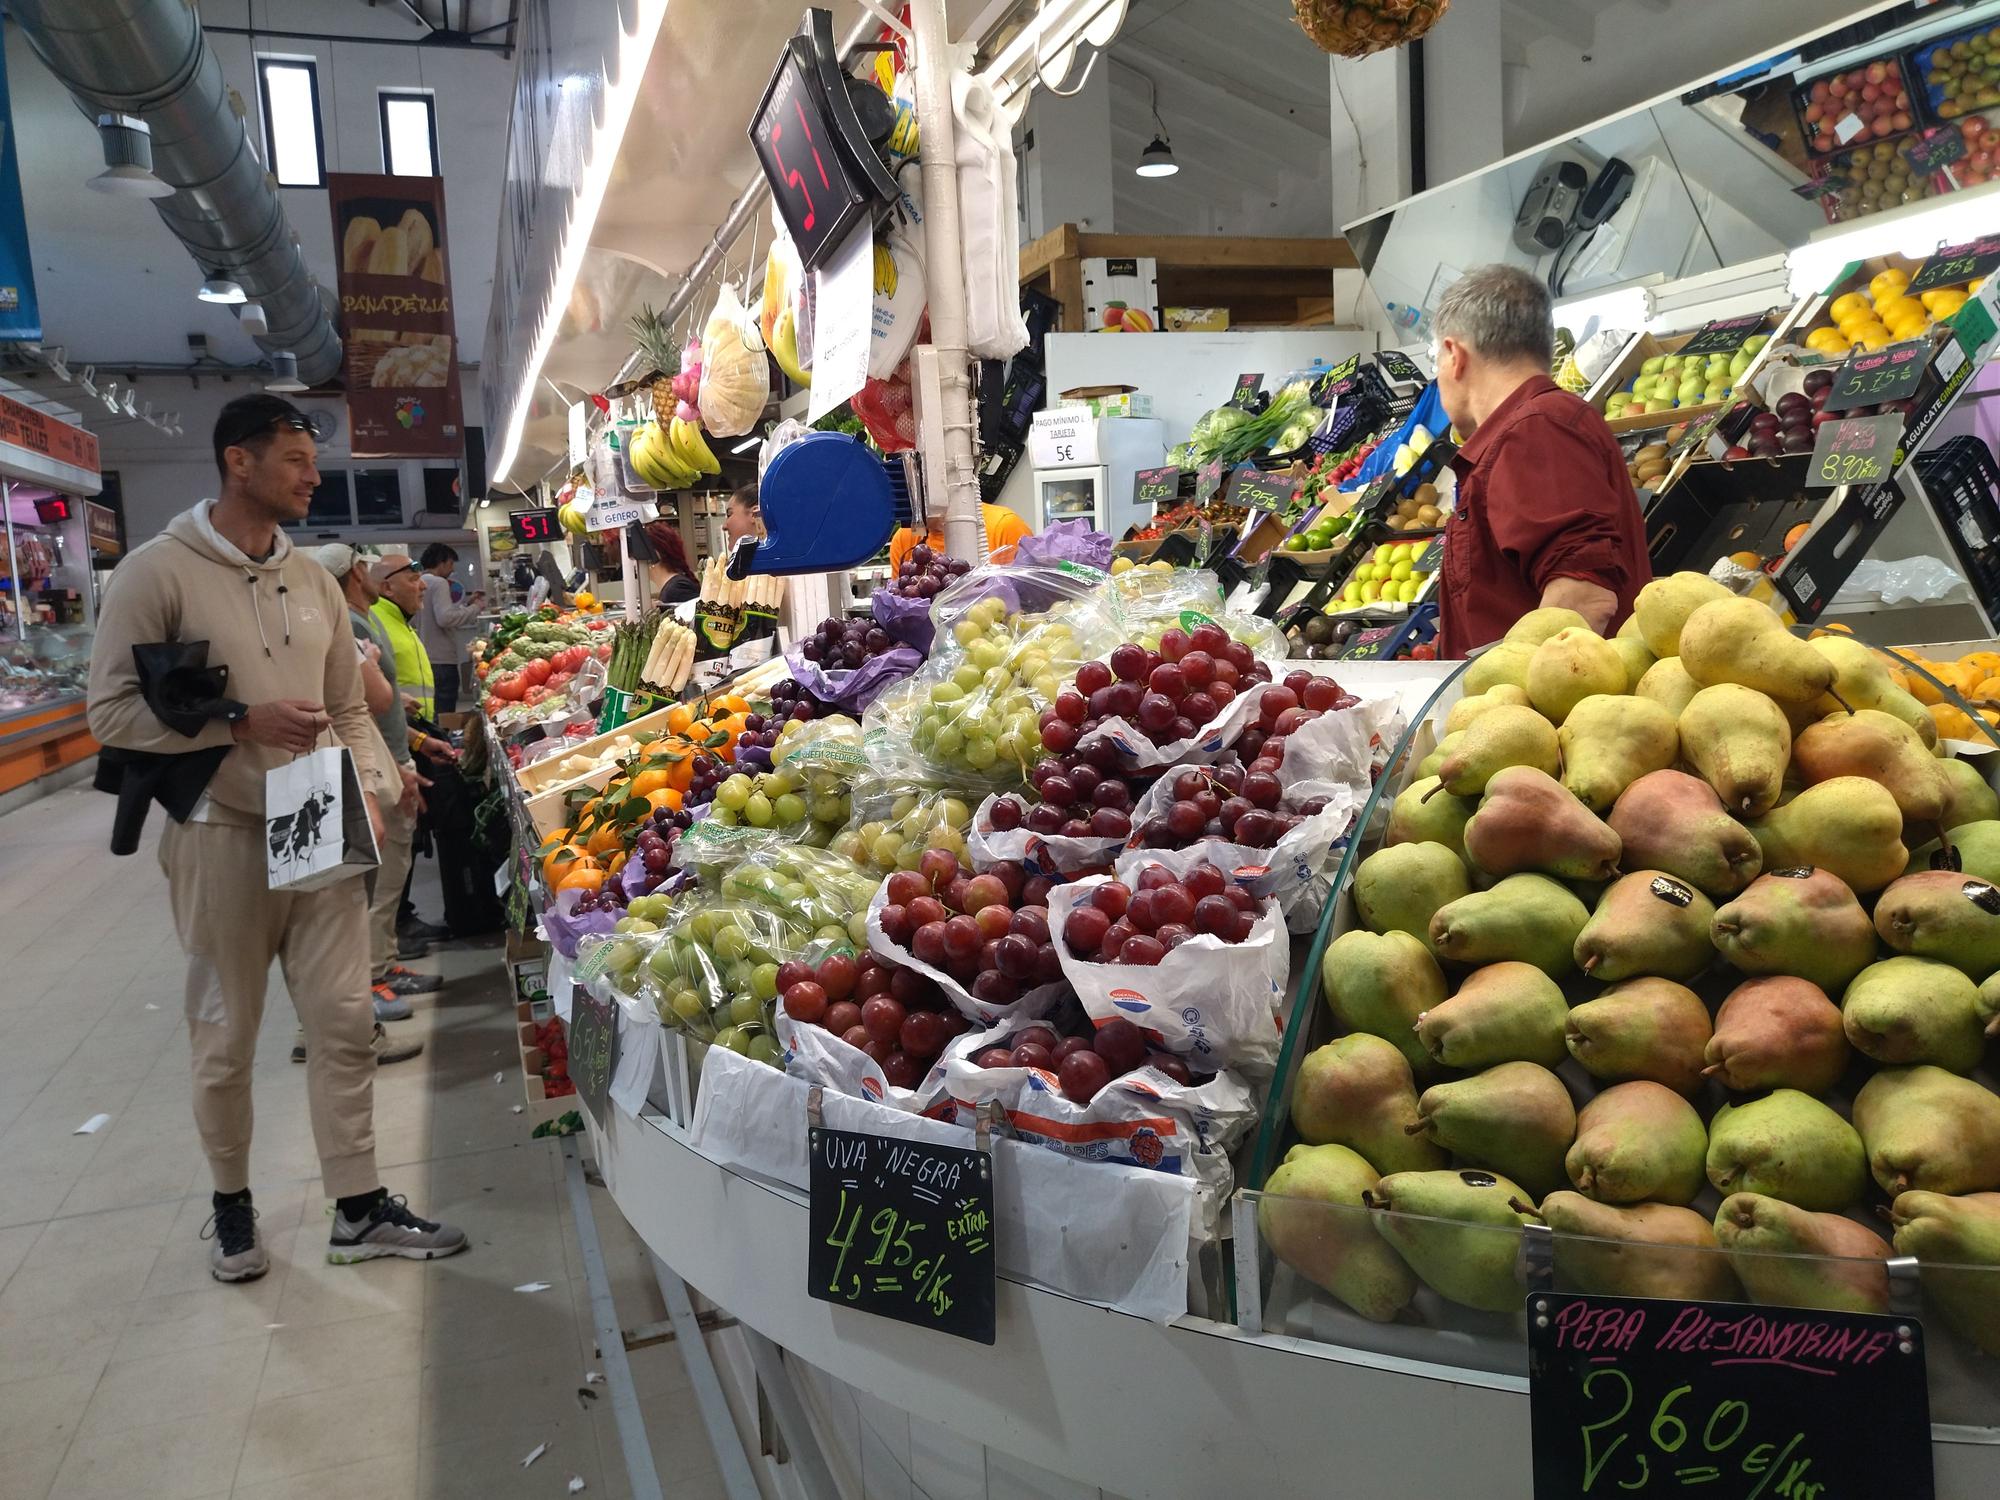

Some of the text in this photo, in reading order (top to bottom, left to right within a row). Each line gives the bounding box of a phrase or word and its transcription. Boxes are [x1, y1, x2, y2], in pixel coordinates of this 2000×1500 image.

[757, 67, 794, 143] SU TURNO
[771, 97, 831, 232] 51
[1035, 418, 1053, 428] PAGO
[1050, 428, 1076, 439] TARJETA
[1056, 444, 1075, 461] 5€
[520, 515, 549, 539] 51
[590, 510, 639, 526] EL GENERO
[826, 1136, 868, 1172] UVA
[947, 1209, 990, 1241] EXTRA
[1554, 1300, 1647, 1351] PERA
[1580, 1367, 1750, 1493] 2,60
